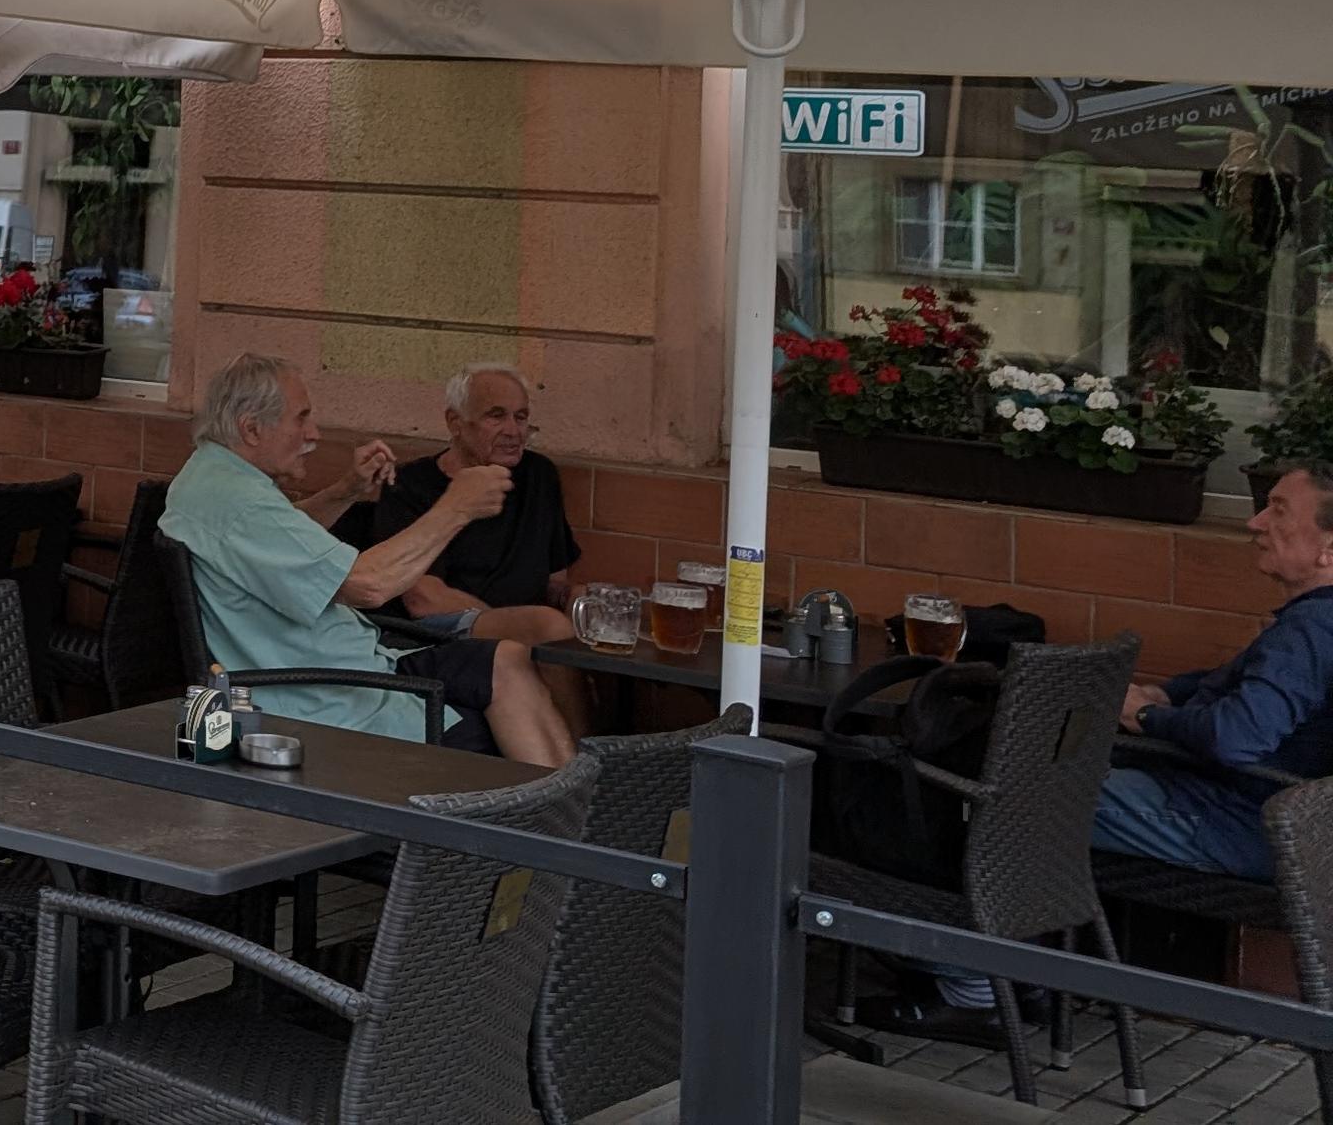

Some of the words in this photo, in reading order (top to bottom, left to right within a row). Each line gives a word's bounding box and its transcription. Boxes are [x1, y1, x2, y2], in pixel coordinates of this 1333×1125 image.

[783, 99, 907, 145] WiFi
[1090, 104, 1201, 143] ZALOŽENO
[1208, 102, 1237, 118] NA
